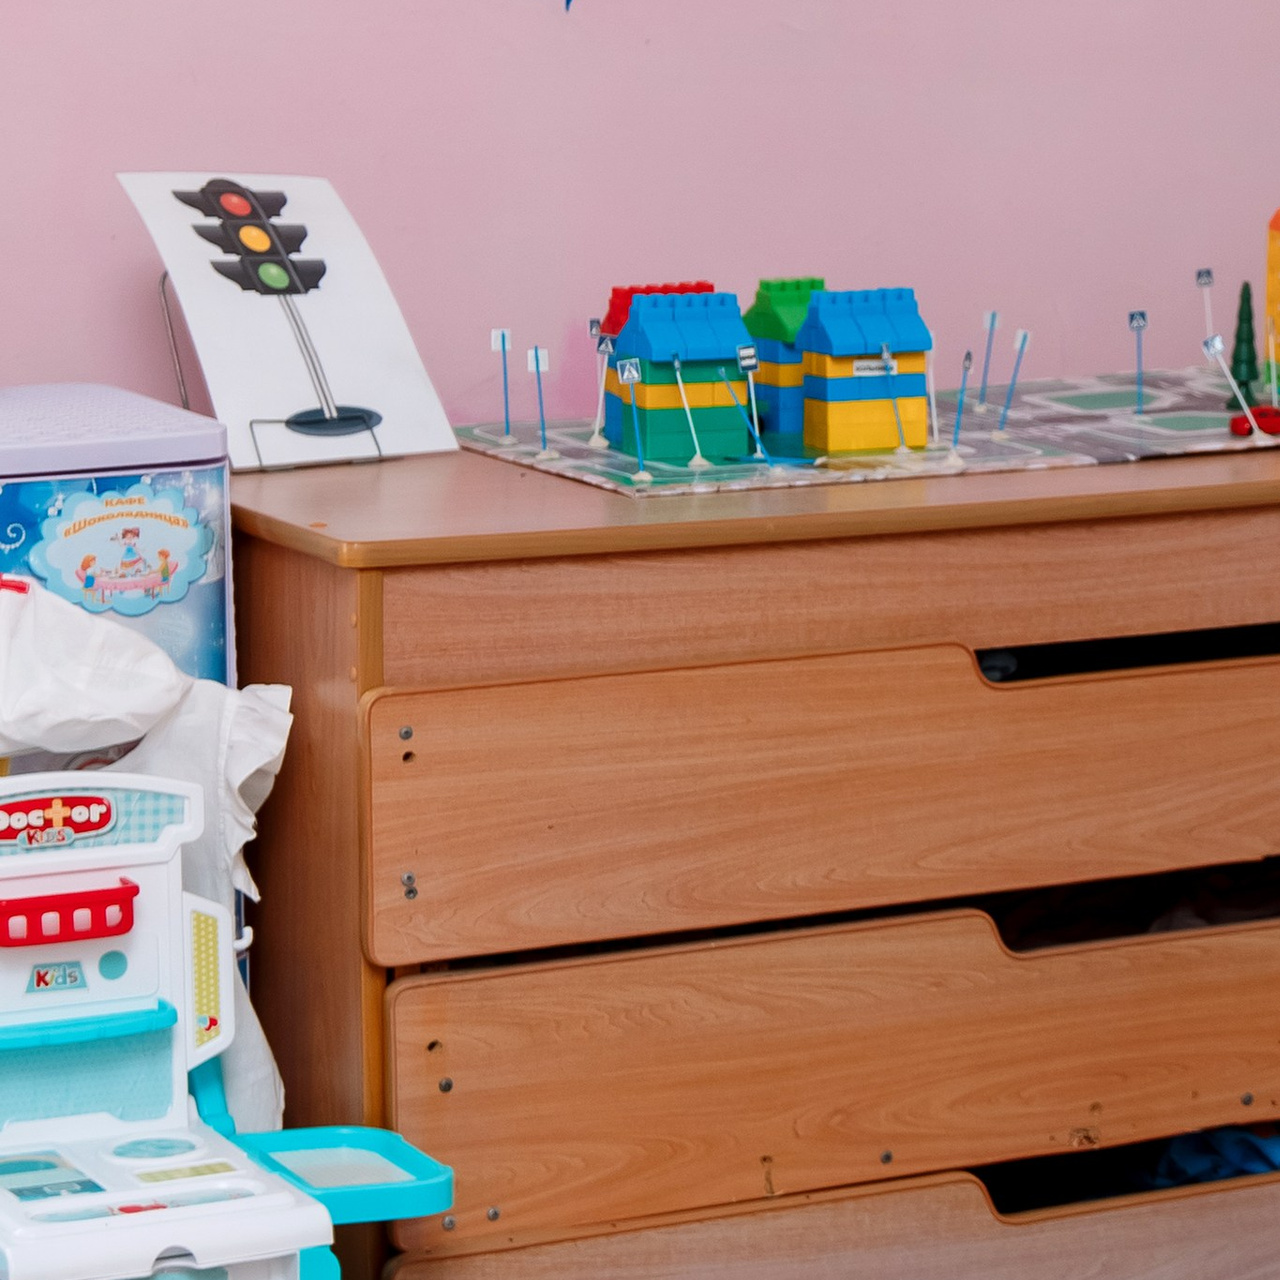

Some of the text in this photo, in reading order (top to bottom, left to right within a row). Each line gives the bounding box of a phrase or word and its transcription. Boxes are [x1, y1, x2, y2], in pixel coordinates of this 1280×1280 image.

[104, 496, 146, 508] КАФЕ
[63, 510, 189, 539] «Шоколадница»
[35, 965, 79, 987] Kids
